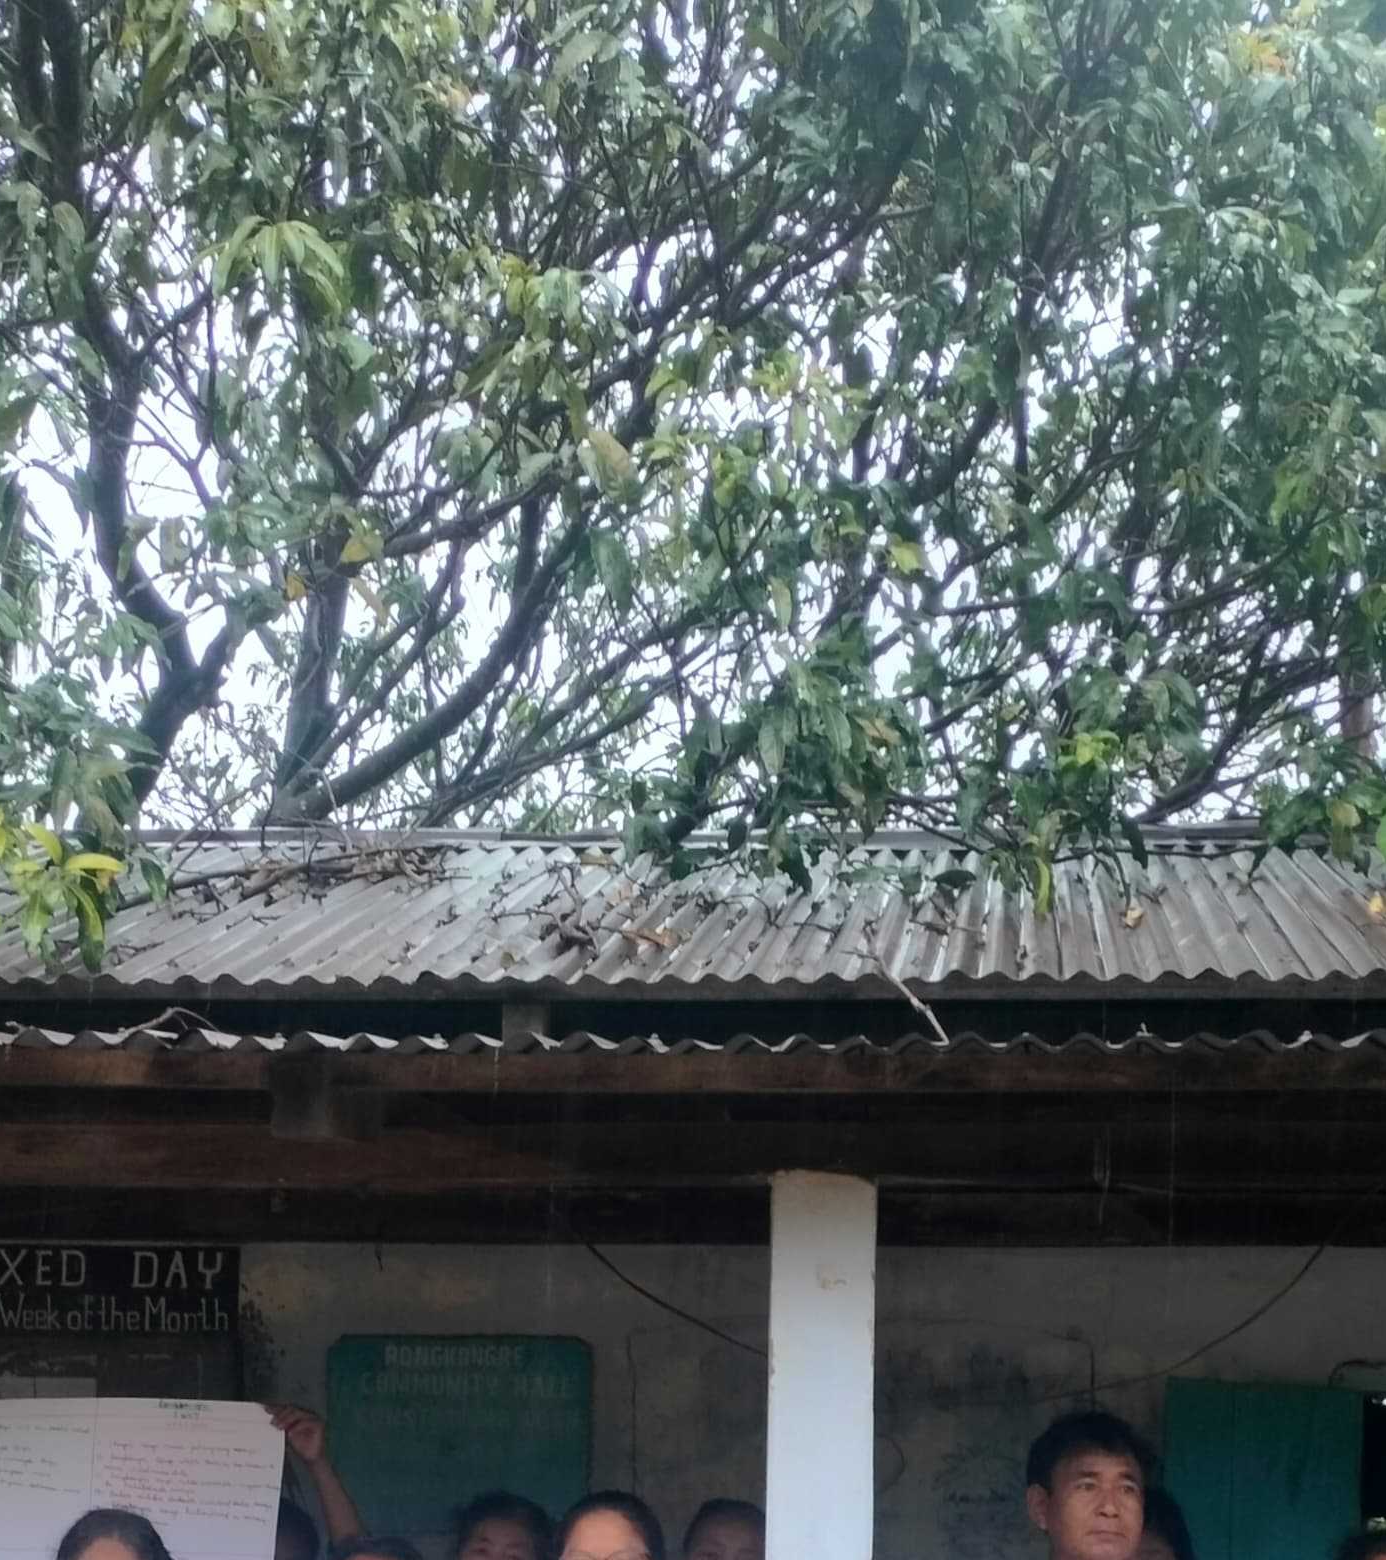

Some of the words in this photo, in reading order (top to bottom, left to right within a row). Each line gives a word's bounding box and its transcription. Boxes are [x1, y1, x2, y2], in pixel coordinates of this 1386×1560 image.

[132, 1250, 223, 1289] DAY
[99, 1295, 141, 1331] the
[144, 1295, 229, 1332] Month
